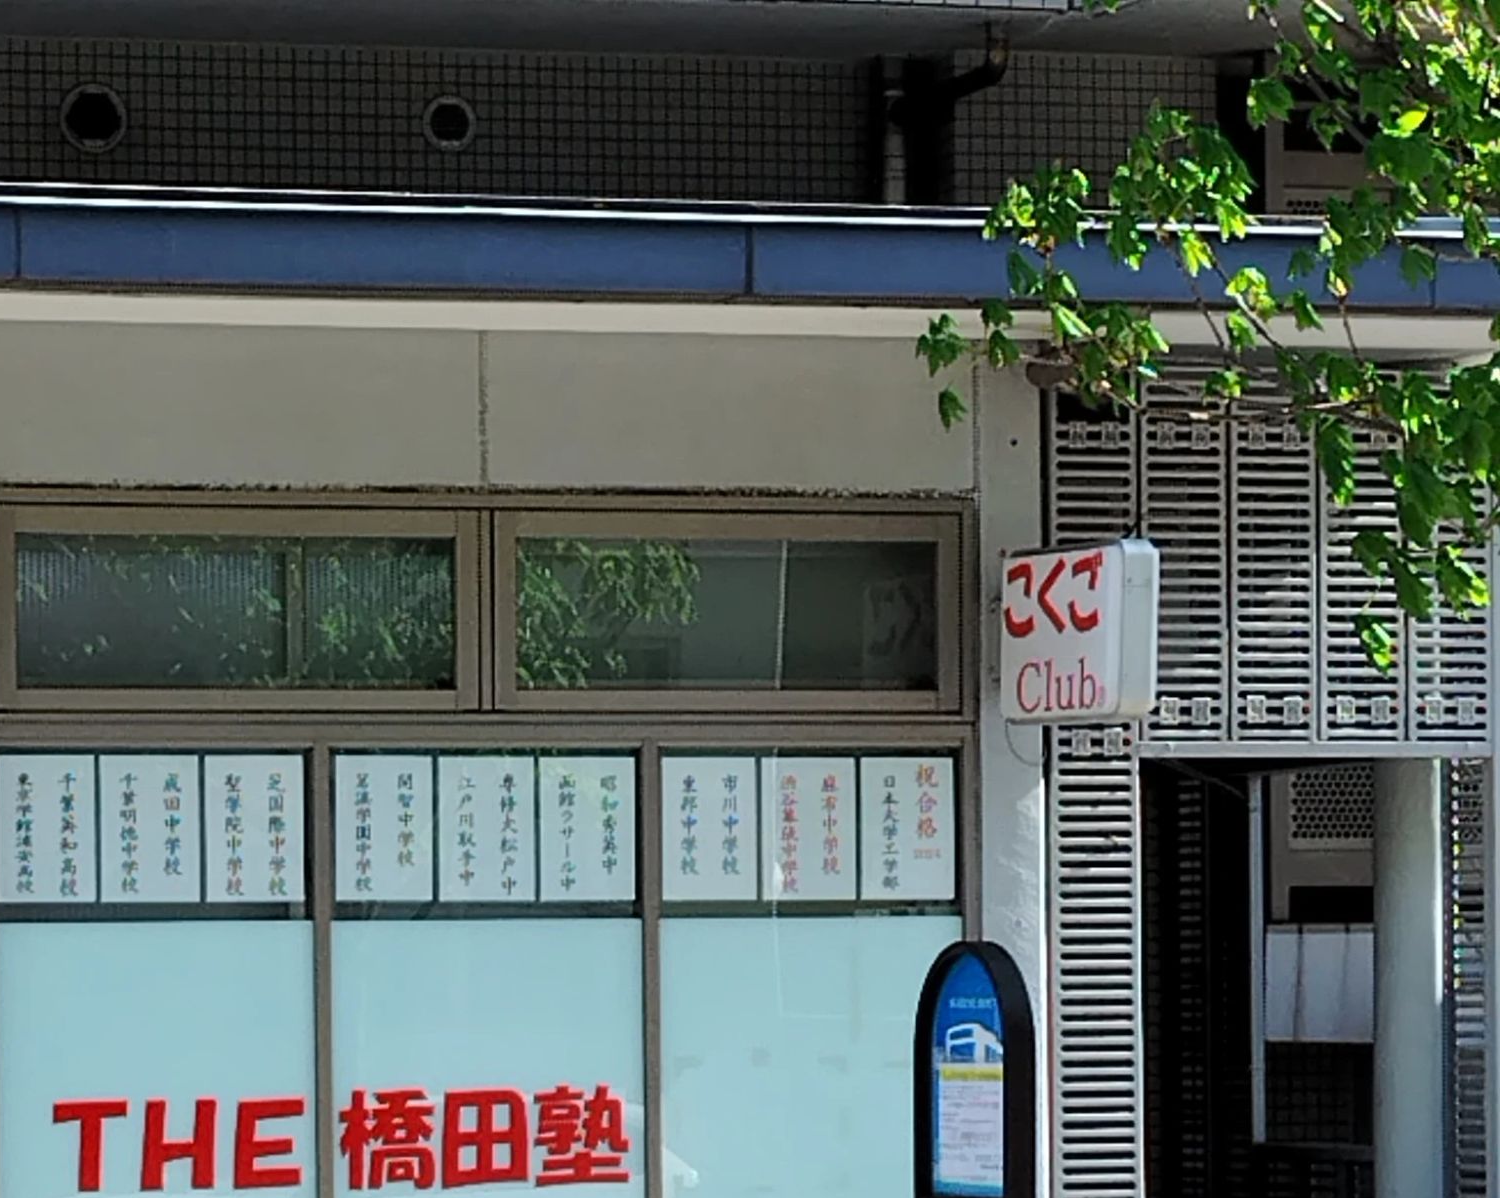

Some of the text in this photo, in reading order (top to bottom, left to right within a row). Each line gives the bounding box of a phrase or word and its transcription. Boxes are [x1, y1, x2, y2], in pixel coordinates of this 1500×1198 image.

[1004, 551, 1103, 638] こくご
[723, 775, 739, 874] 市川中学校
[915, 763, 940, 841] 祝合格
[54, 1083, 632, 1191] THE 橋田塾
